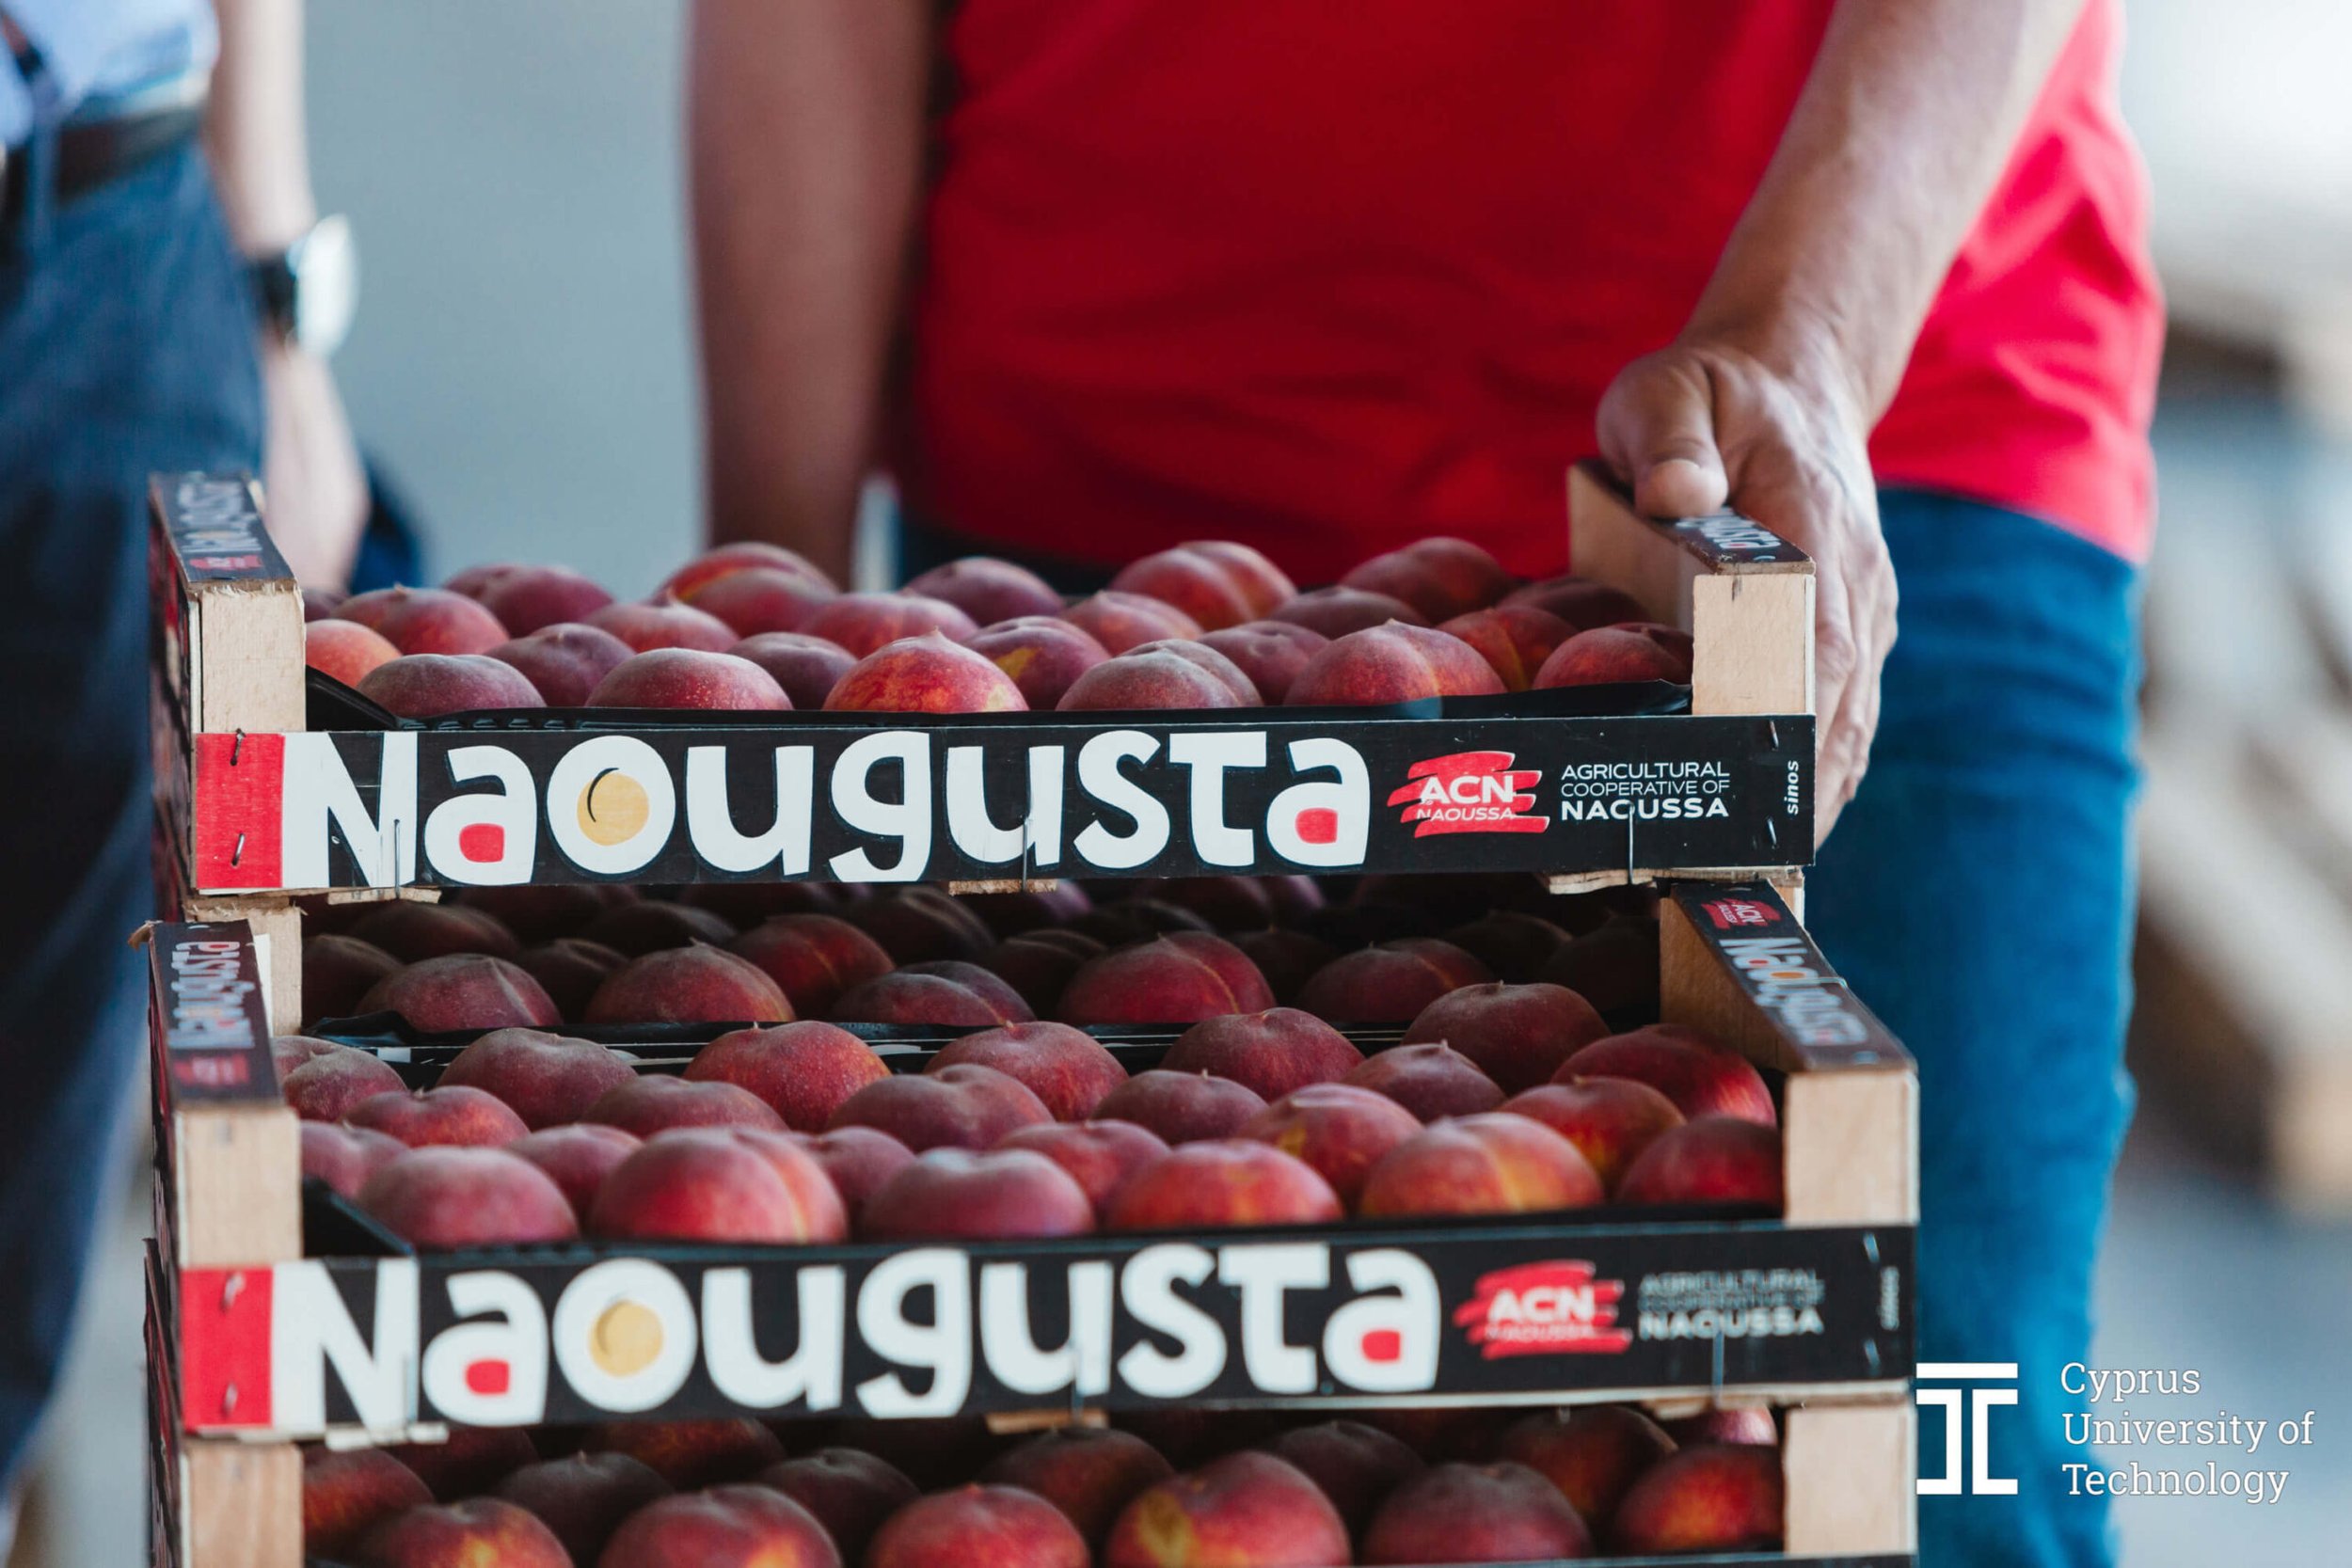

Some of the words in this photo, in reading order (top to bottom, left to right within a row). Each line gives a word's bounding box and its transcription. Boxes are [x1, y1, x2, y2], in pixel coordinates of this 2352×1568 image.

[1561, 761, 1731, 781] AGRICULTURAL
[1420, 775, 1514, 804] ACN
[1561, 781, 1698, 798] COOPERATIVE
[1702, 780, 1731, 794] OF
[1785, 760, 1800, 816] sinos
[283, 730, 1371, 882] Naougusta
[1416, 807, 1517, 822] NAOUSSA
[1561, 798, 1729, 821] NAOUSSA
[1487, 1286, 1595, 1323] ACN
[272, 1243, 1441, 1431] Naougusta
